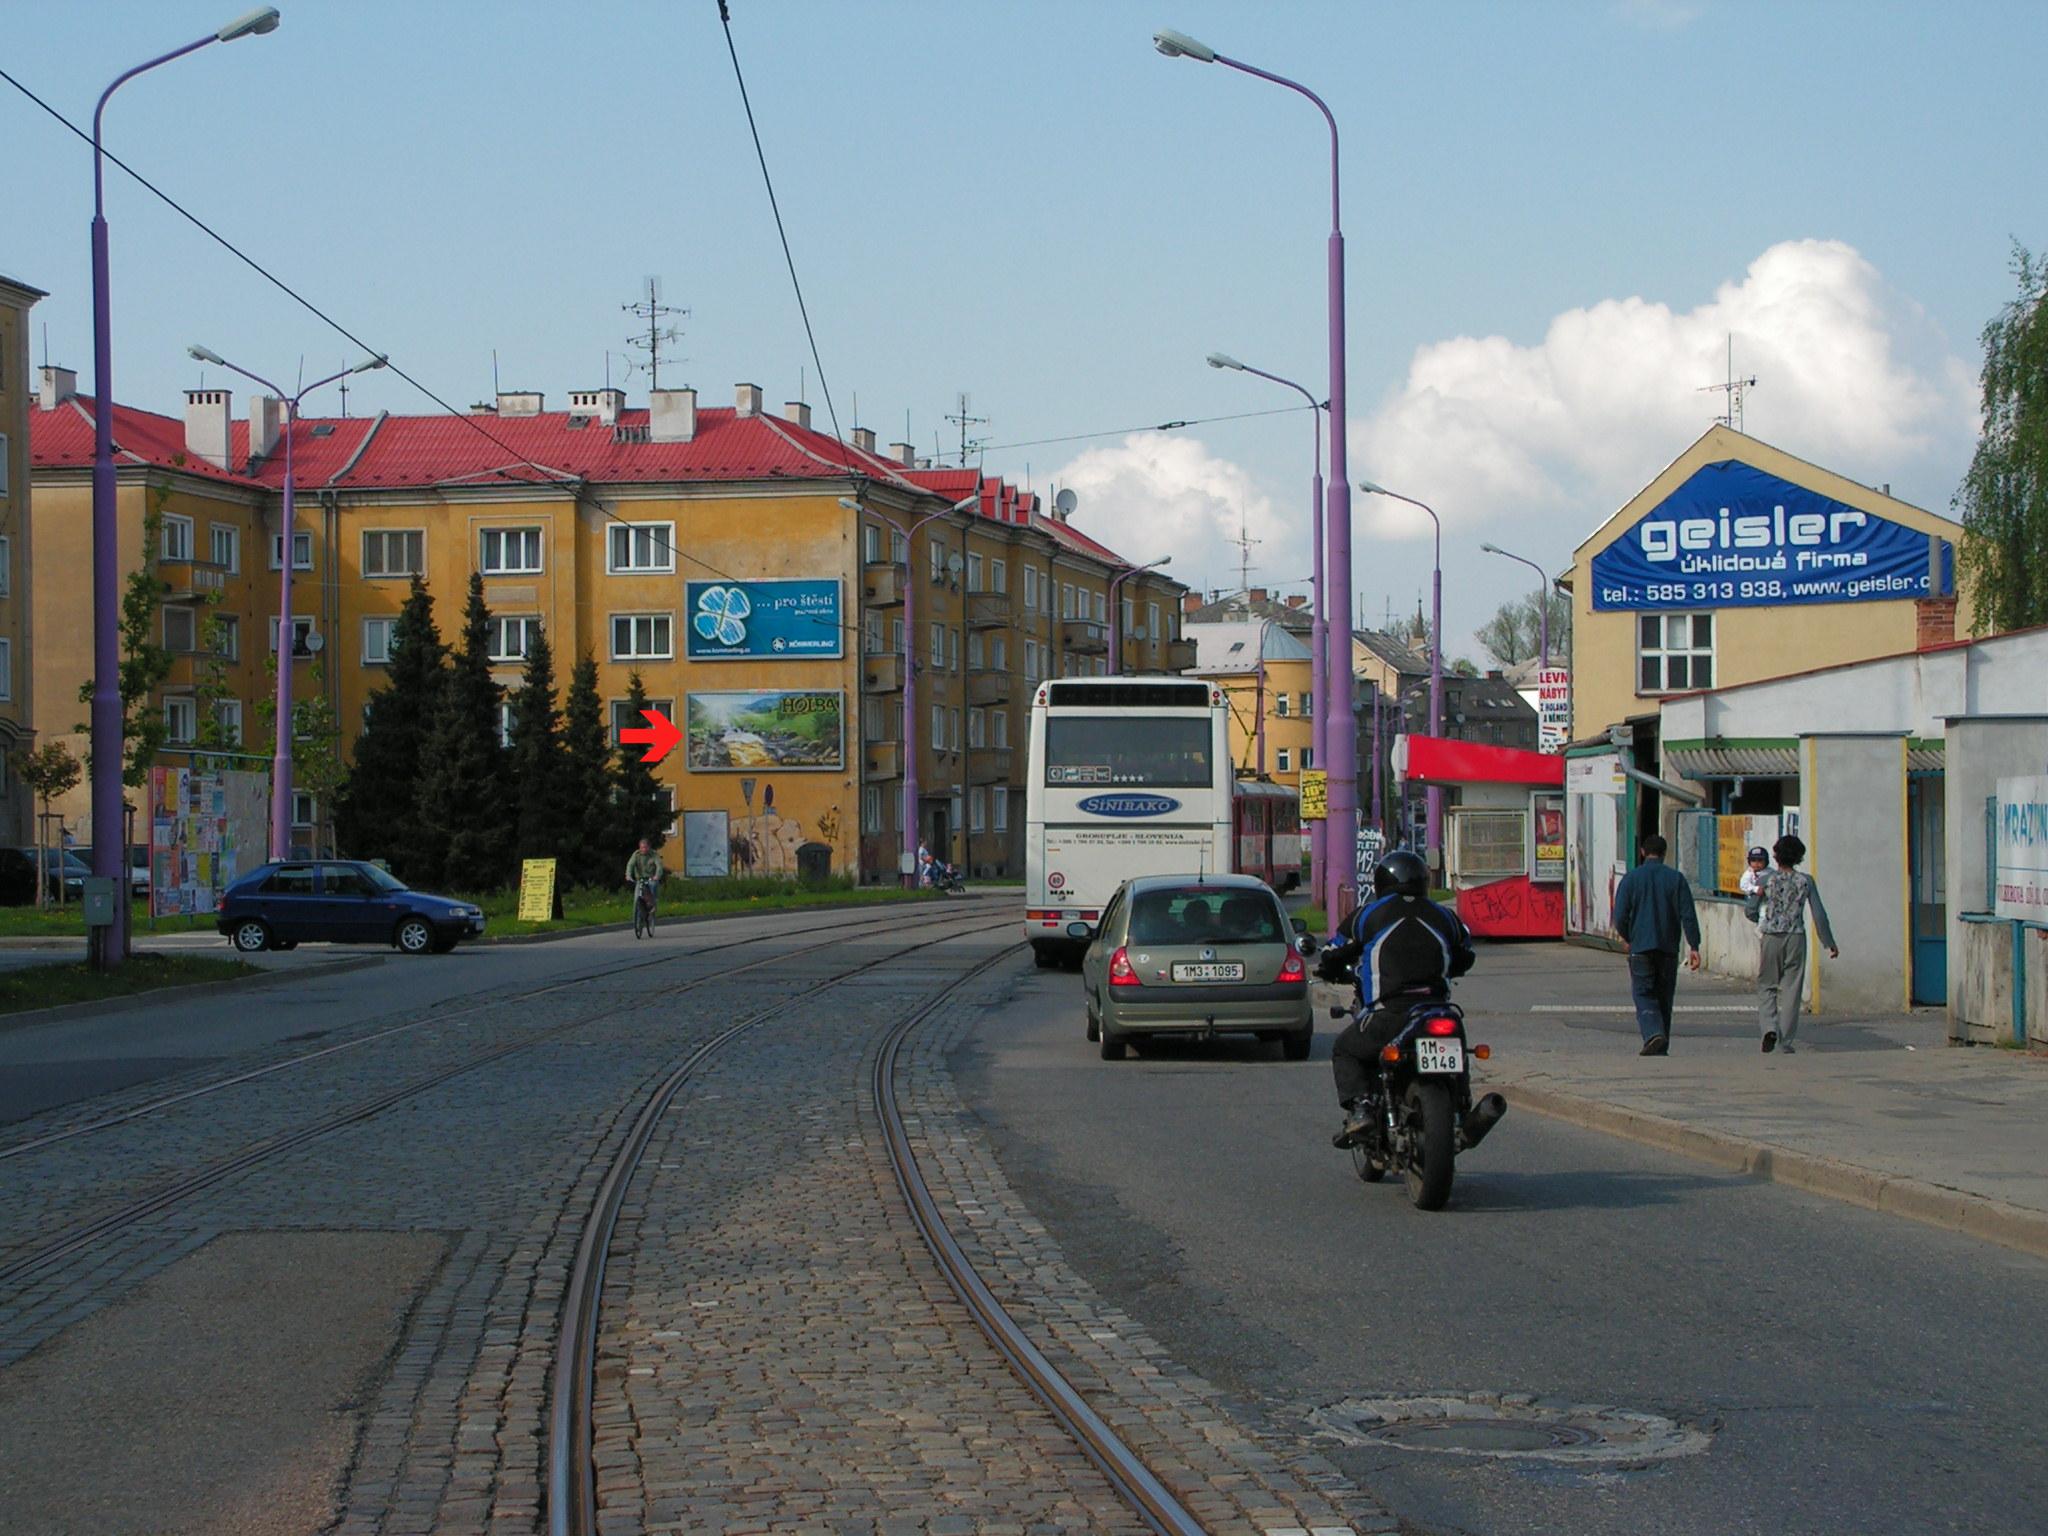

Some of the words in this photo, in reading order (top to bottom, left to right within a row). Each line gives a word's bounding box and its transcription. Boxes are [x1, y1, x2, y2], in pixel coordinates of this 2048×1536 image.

[1640, 505, 1867, 562] geisler
[1796, 551, 1868, 571] firma
[1602, 585, 1640, 602] tel.:
[1646, 584, 1686, 601] 585
[1693, 582, 1733, 600] 313
[1740, 580, 1788, 599] 938,
[1792, 575, 1930, 597] www.geisler.c
[774, 598, 797, 610] pro
[800, 593, 834, 607] štěstí
[1539, 671, 1568, 684] LEVN
[1540, 685, 1567, 699] NÁBYT
[782, 697, 839, 713] HOLBA
[1545, 702, 1568, 712] HOLAND
[1548, 712, 1568, 722] NĚMEC
[1183, 965, 1203, 977] 1M3
[1212, 965, 1239, 977] 1095
[1421, 1040, 1438, 1055] 1M
[1421, 1055, 1456, 1070] 8148
